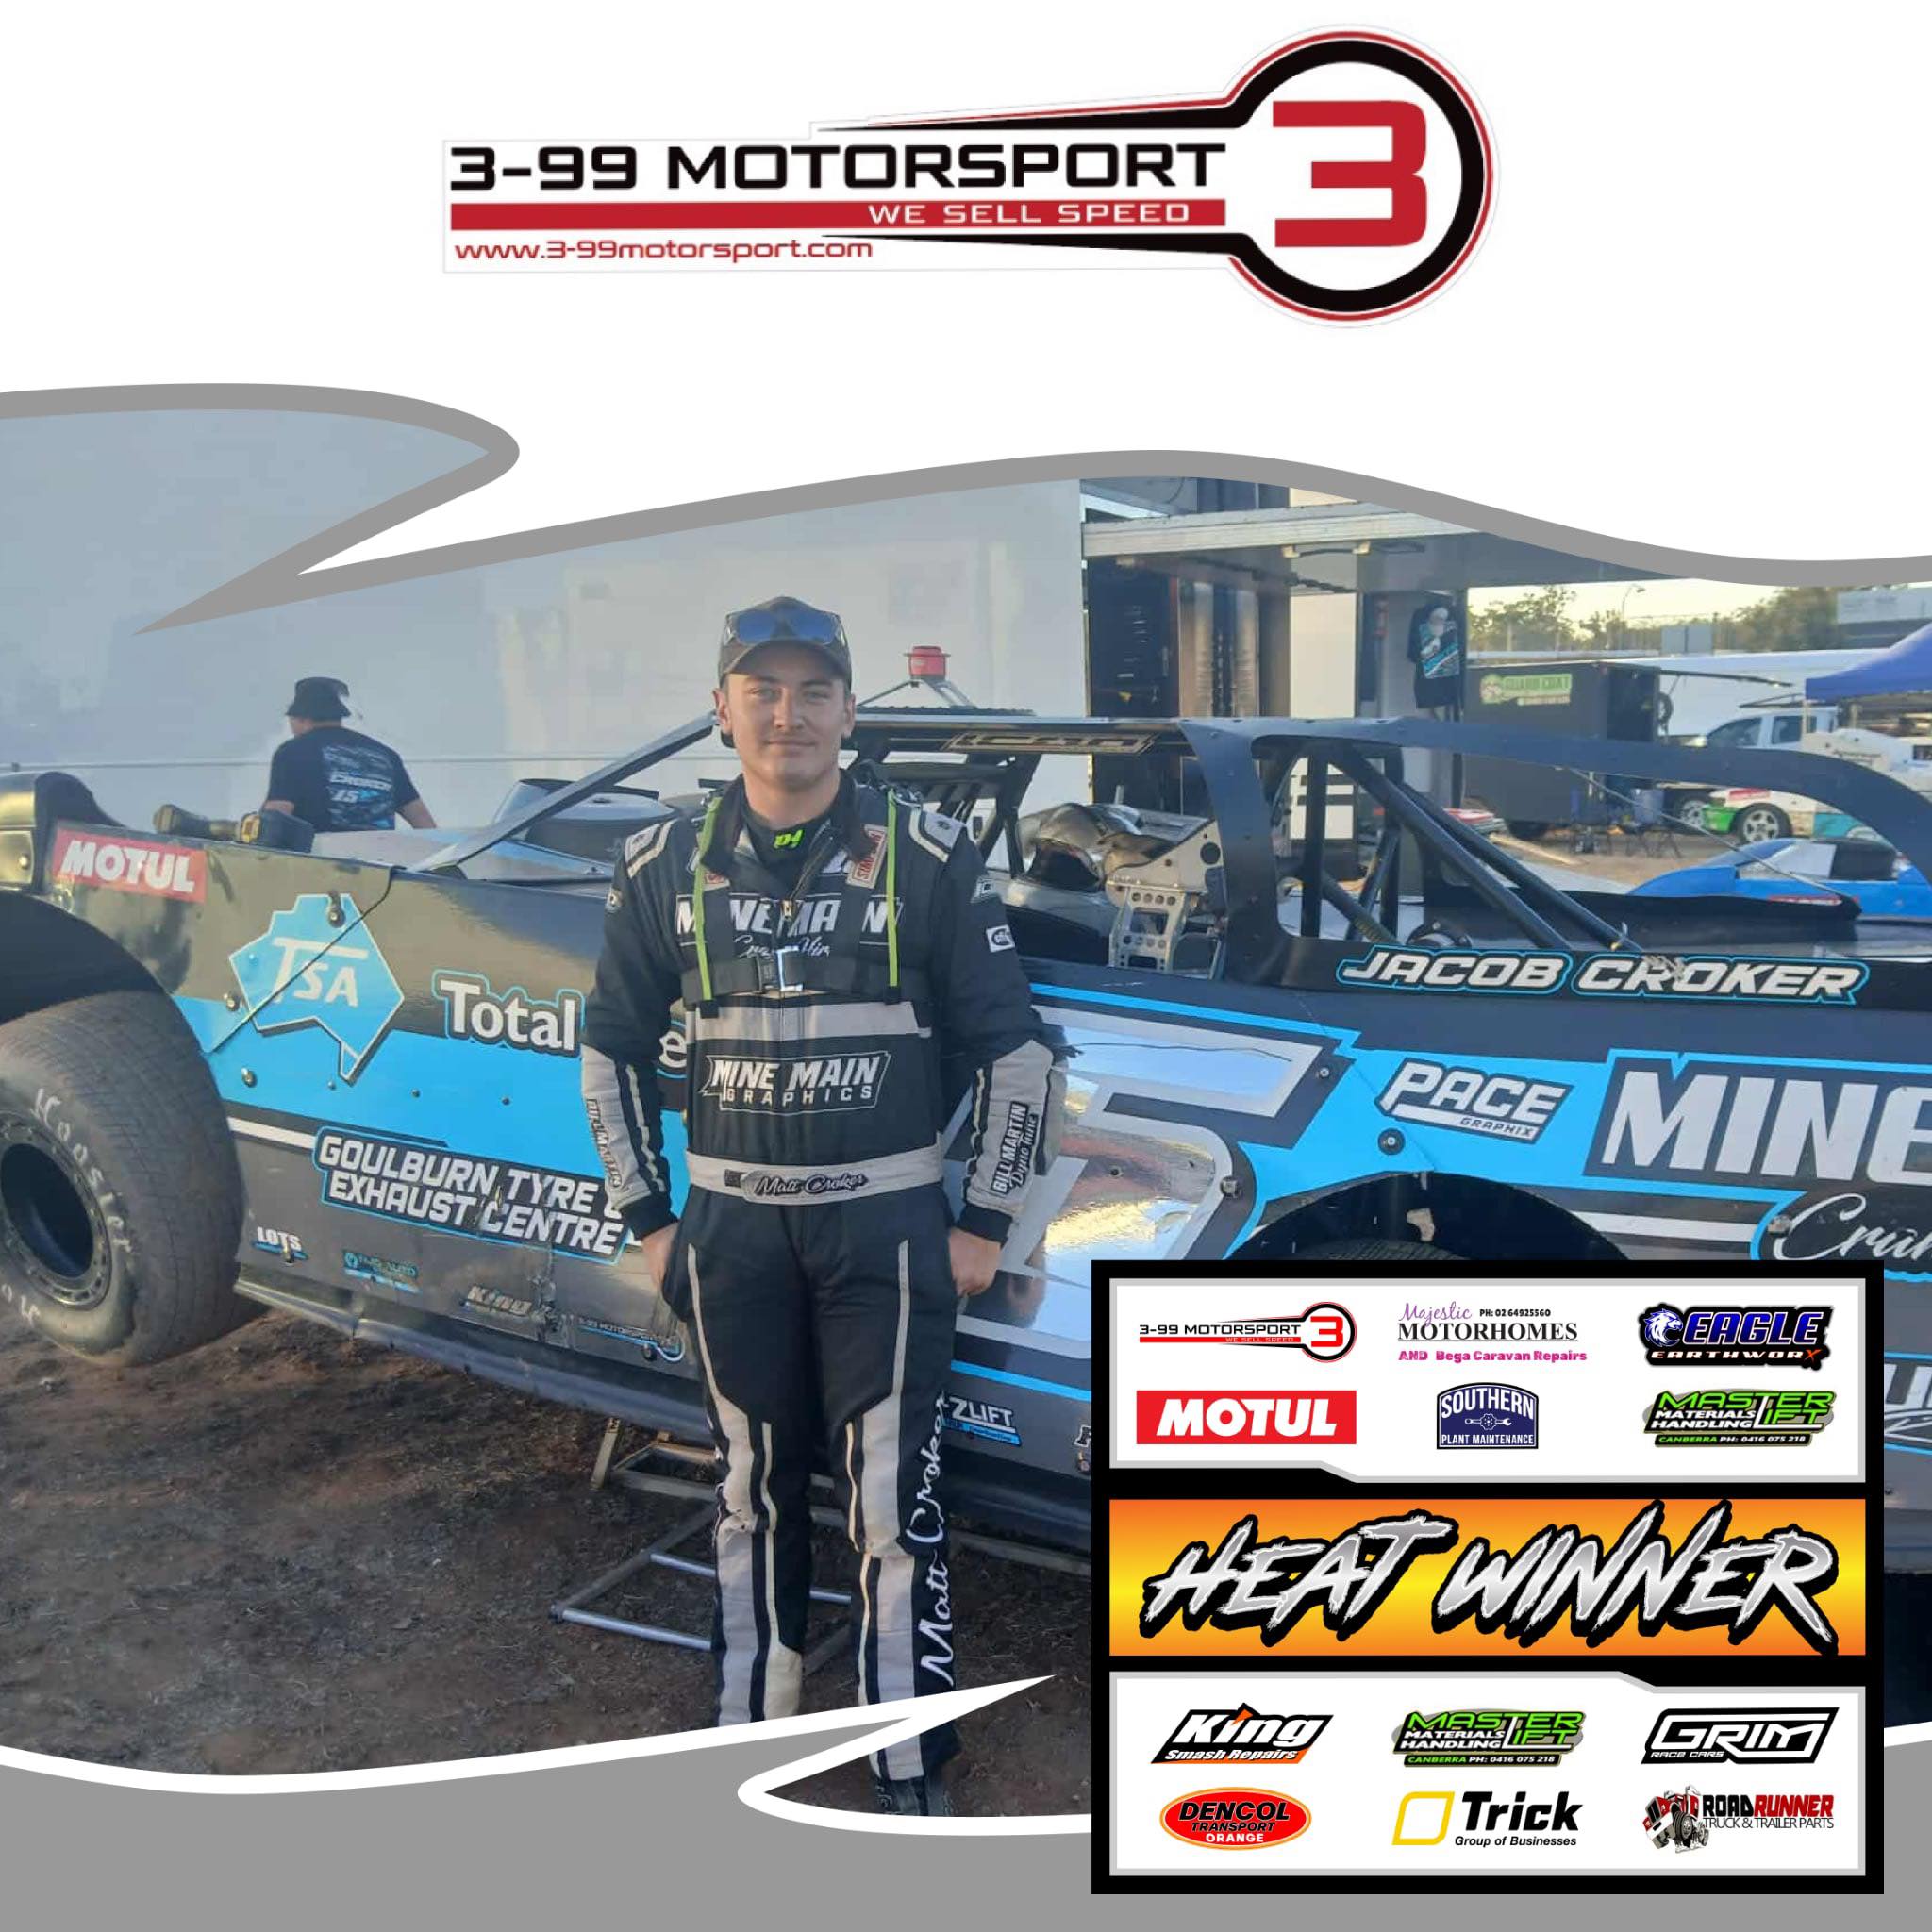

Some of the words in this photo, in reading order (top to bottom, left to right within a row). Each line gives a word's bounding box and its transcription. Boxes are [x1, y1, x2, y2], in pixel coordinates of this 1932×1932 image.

[60, 840, 196, 893] MOTUL
[675, 898, 774, 935] MNE
[777, 897, 903, 939] MAN
[272, 936, 370, 1008] TSA
[1342, 952, 1564, 988] JACOB
[1578, 958, 1867, 1000] CROKER
[438, 977, 576, 1051] Total
[710, 1058, 781, 1091] MINE
[786, 1055, 881, 1091] MAIN
[724, 1085, 873, 1108] GRAPHICS
[1379, 1060, 1568, 1124] PACE
[1001, 1102, 1028, 1162] MARTIN
[1459, 1116, 1535, 1140] GRAPHIX
[319, 1135, 499, 1195] GOULBURN
[505, 1169, 594, 1215] TYRE
[992, 1160, 1014, 1194] BILL
[329, 1174, 477, 1228] EXHAUST
[480, 1199, 625, 1256] CENTRE
[919, 1549, 955, 1687] Matt
